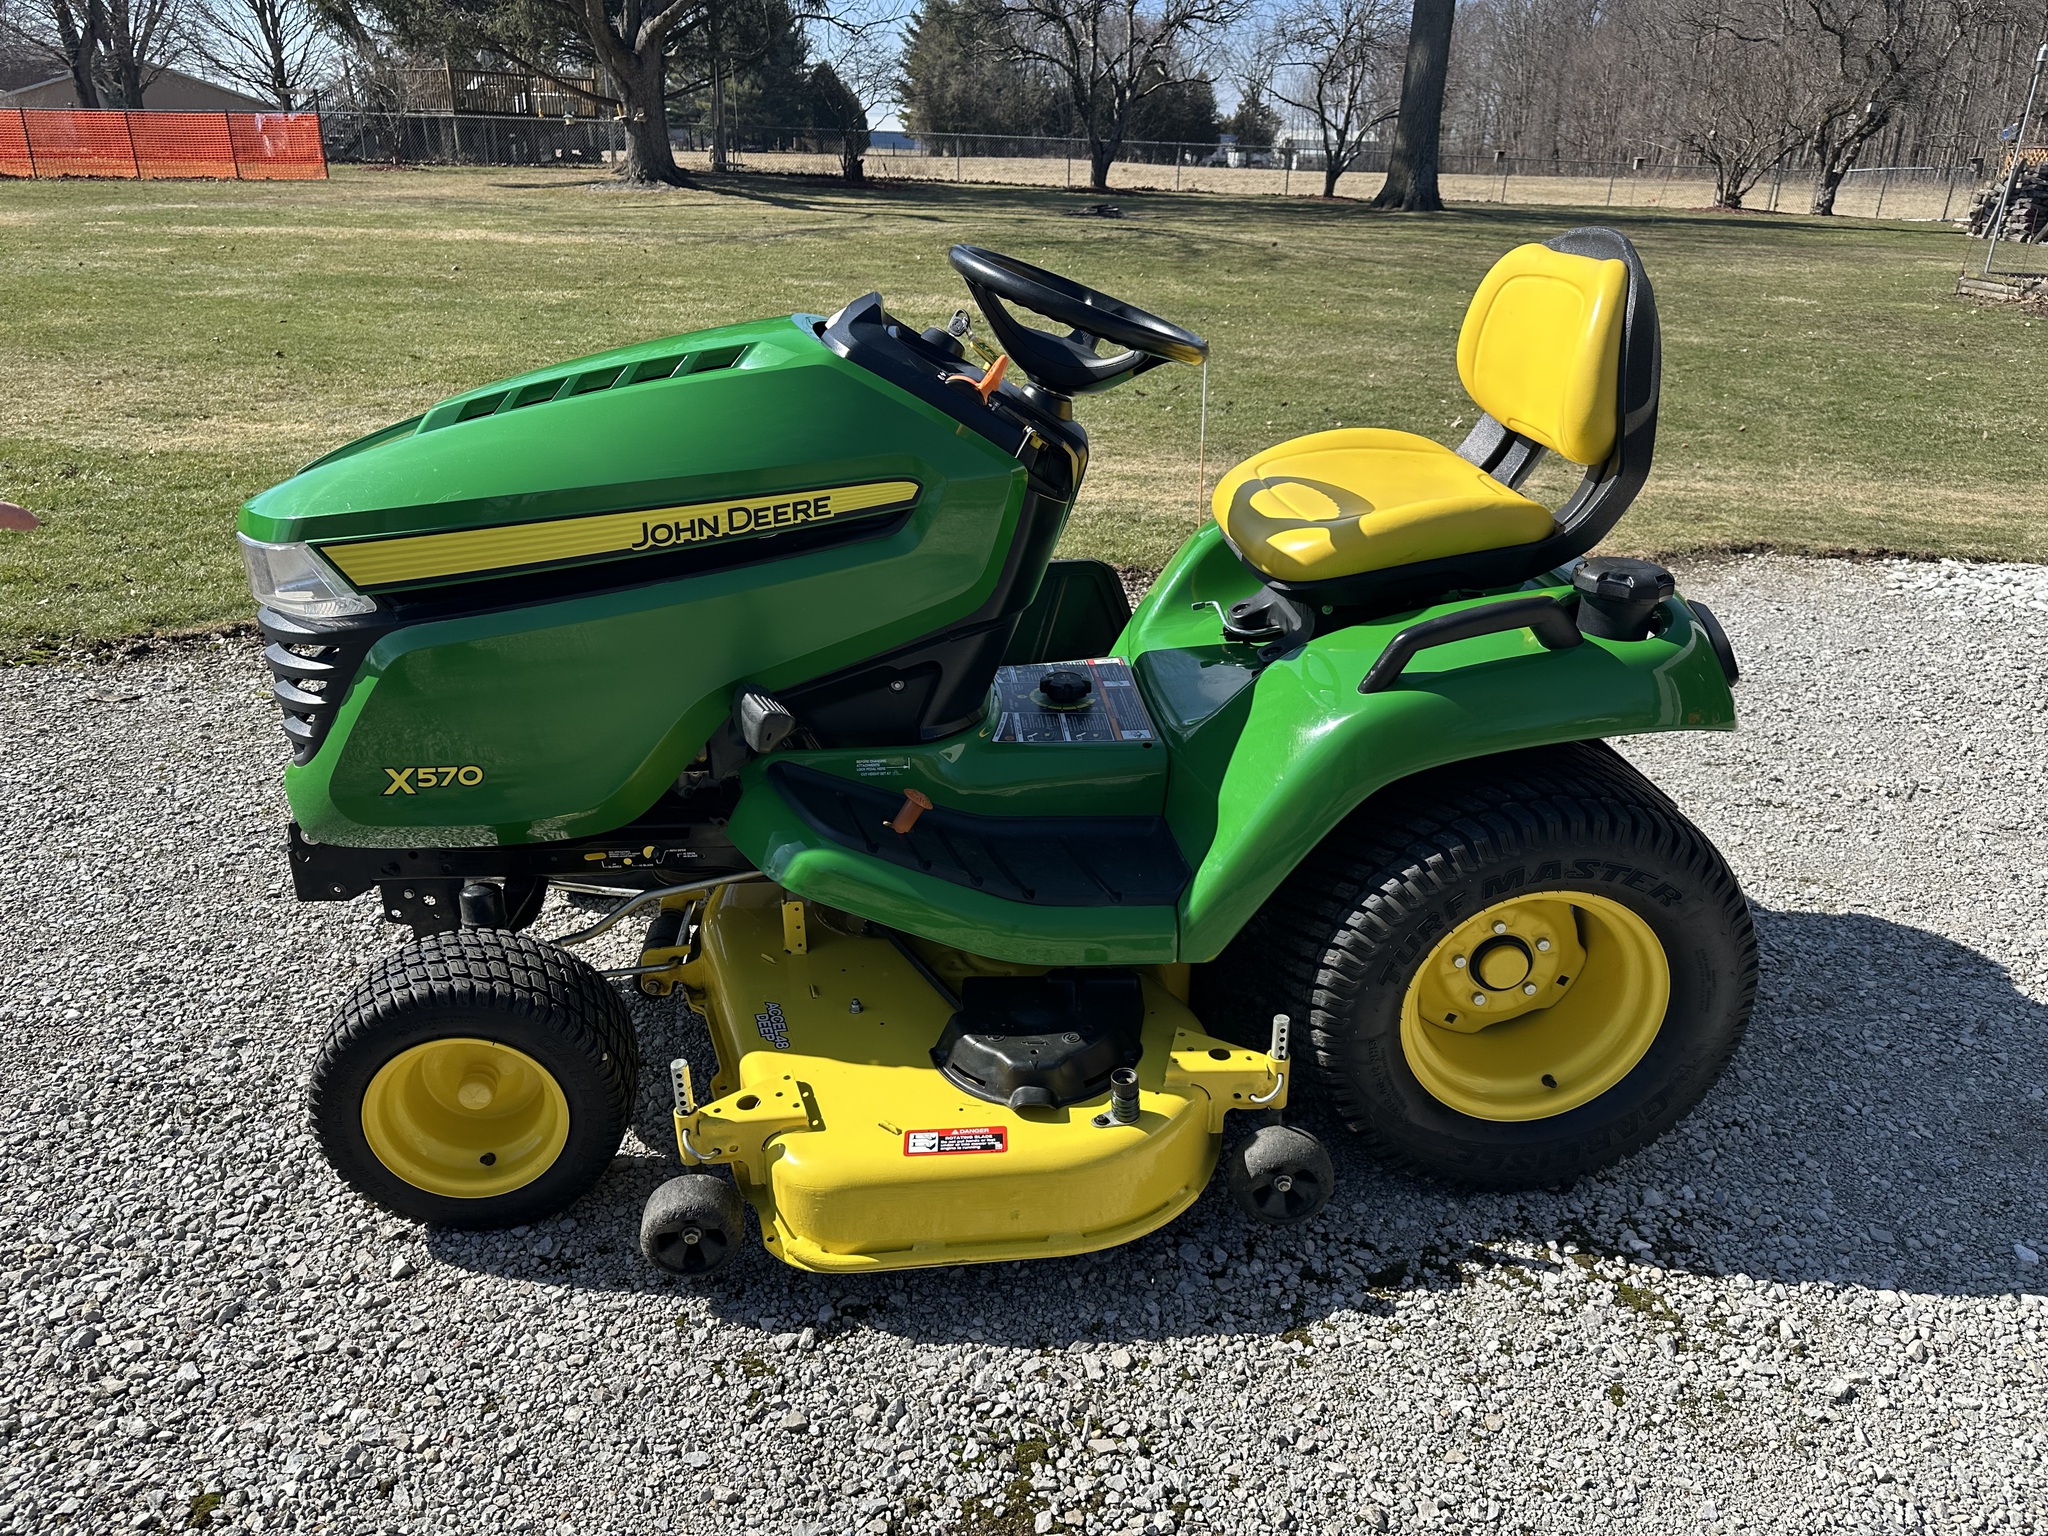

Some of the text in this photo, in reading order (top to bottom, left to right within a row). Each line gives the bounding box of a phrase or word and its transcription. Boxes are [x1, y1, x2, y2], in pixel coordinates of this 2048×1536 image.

[632, 496, 832, 549] JOHN DEERE
[382, 766, 483, 795] X570
[1378, 858, 1684, 986] TURF MASTER
[755, 1014, 776, 1042] DEEP
